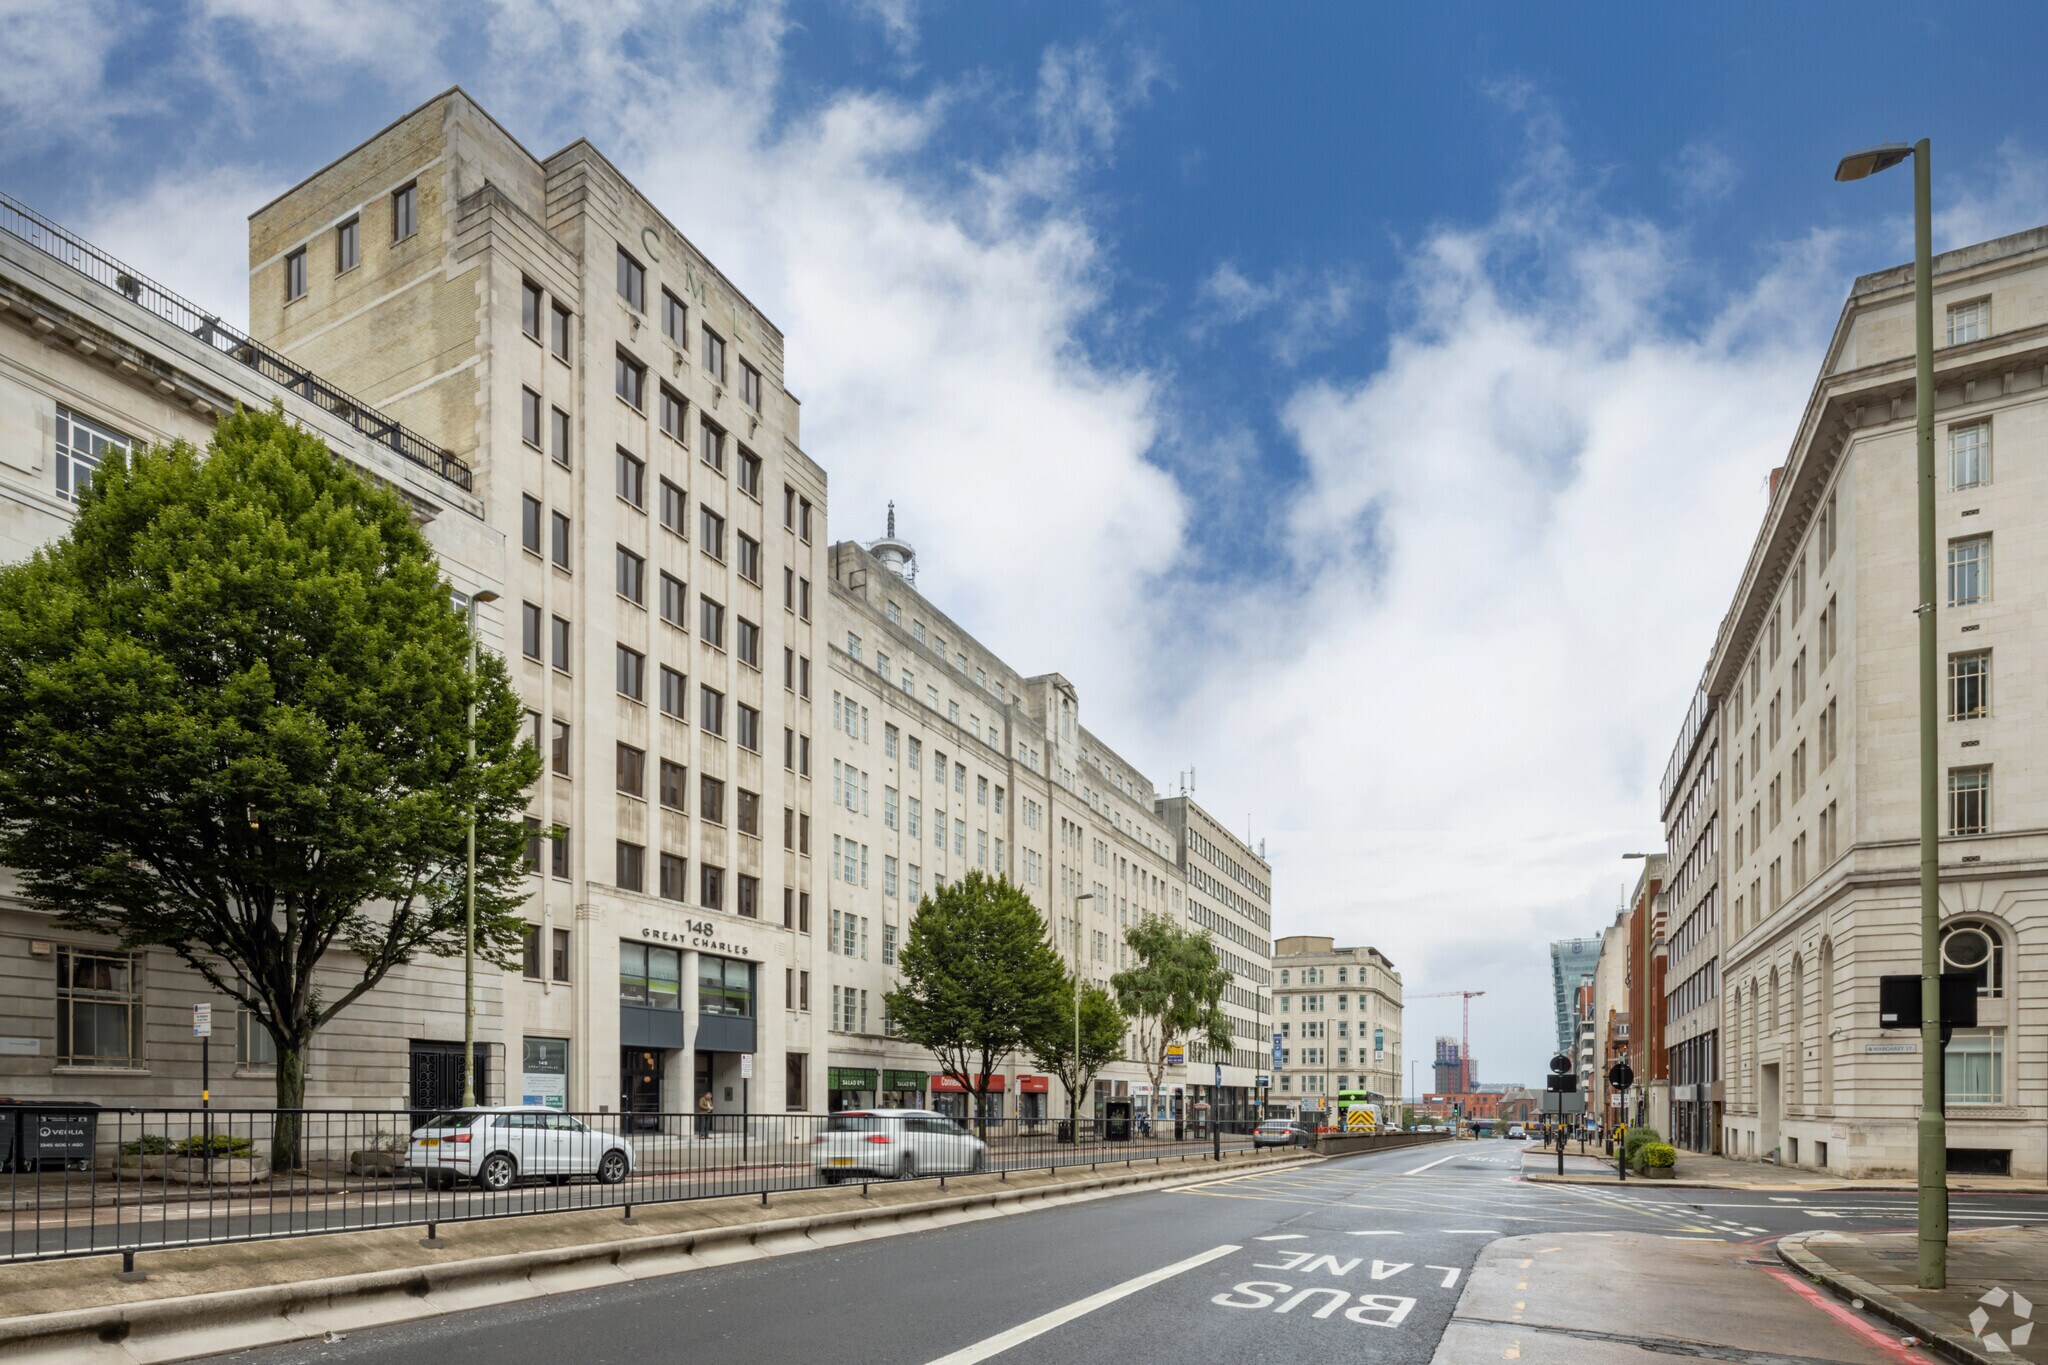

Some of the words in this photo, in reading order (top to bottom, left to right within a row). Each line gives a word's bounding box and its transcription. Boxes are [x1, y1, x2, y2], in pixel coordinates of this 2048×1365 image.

[642, 928, 685, 943] GREAT
[692, 938, 749, 955] CHARLES
[685, 919, 714, 937] 148
[1253, 1250, 1463, 1288] LANE
[1211, 1281, 1418, 1329] BUS
